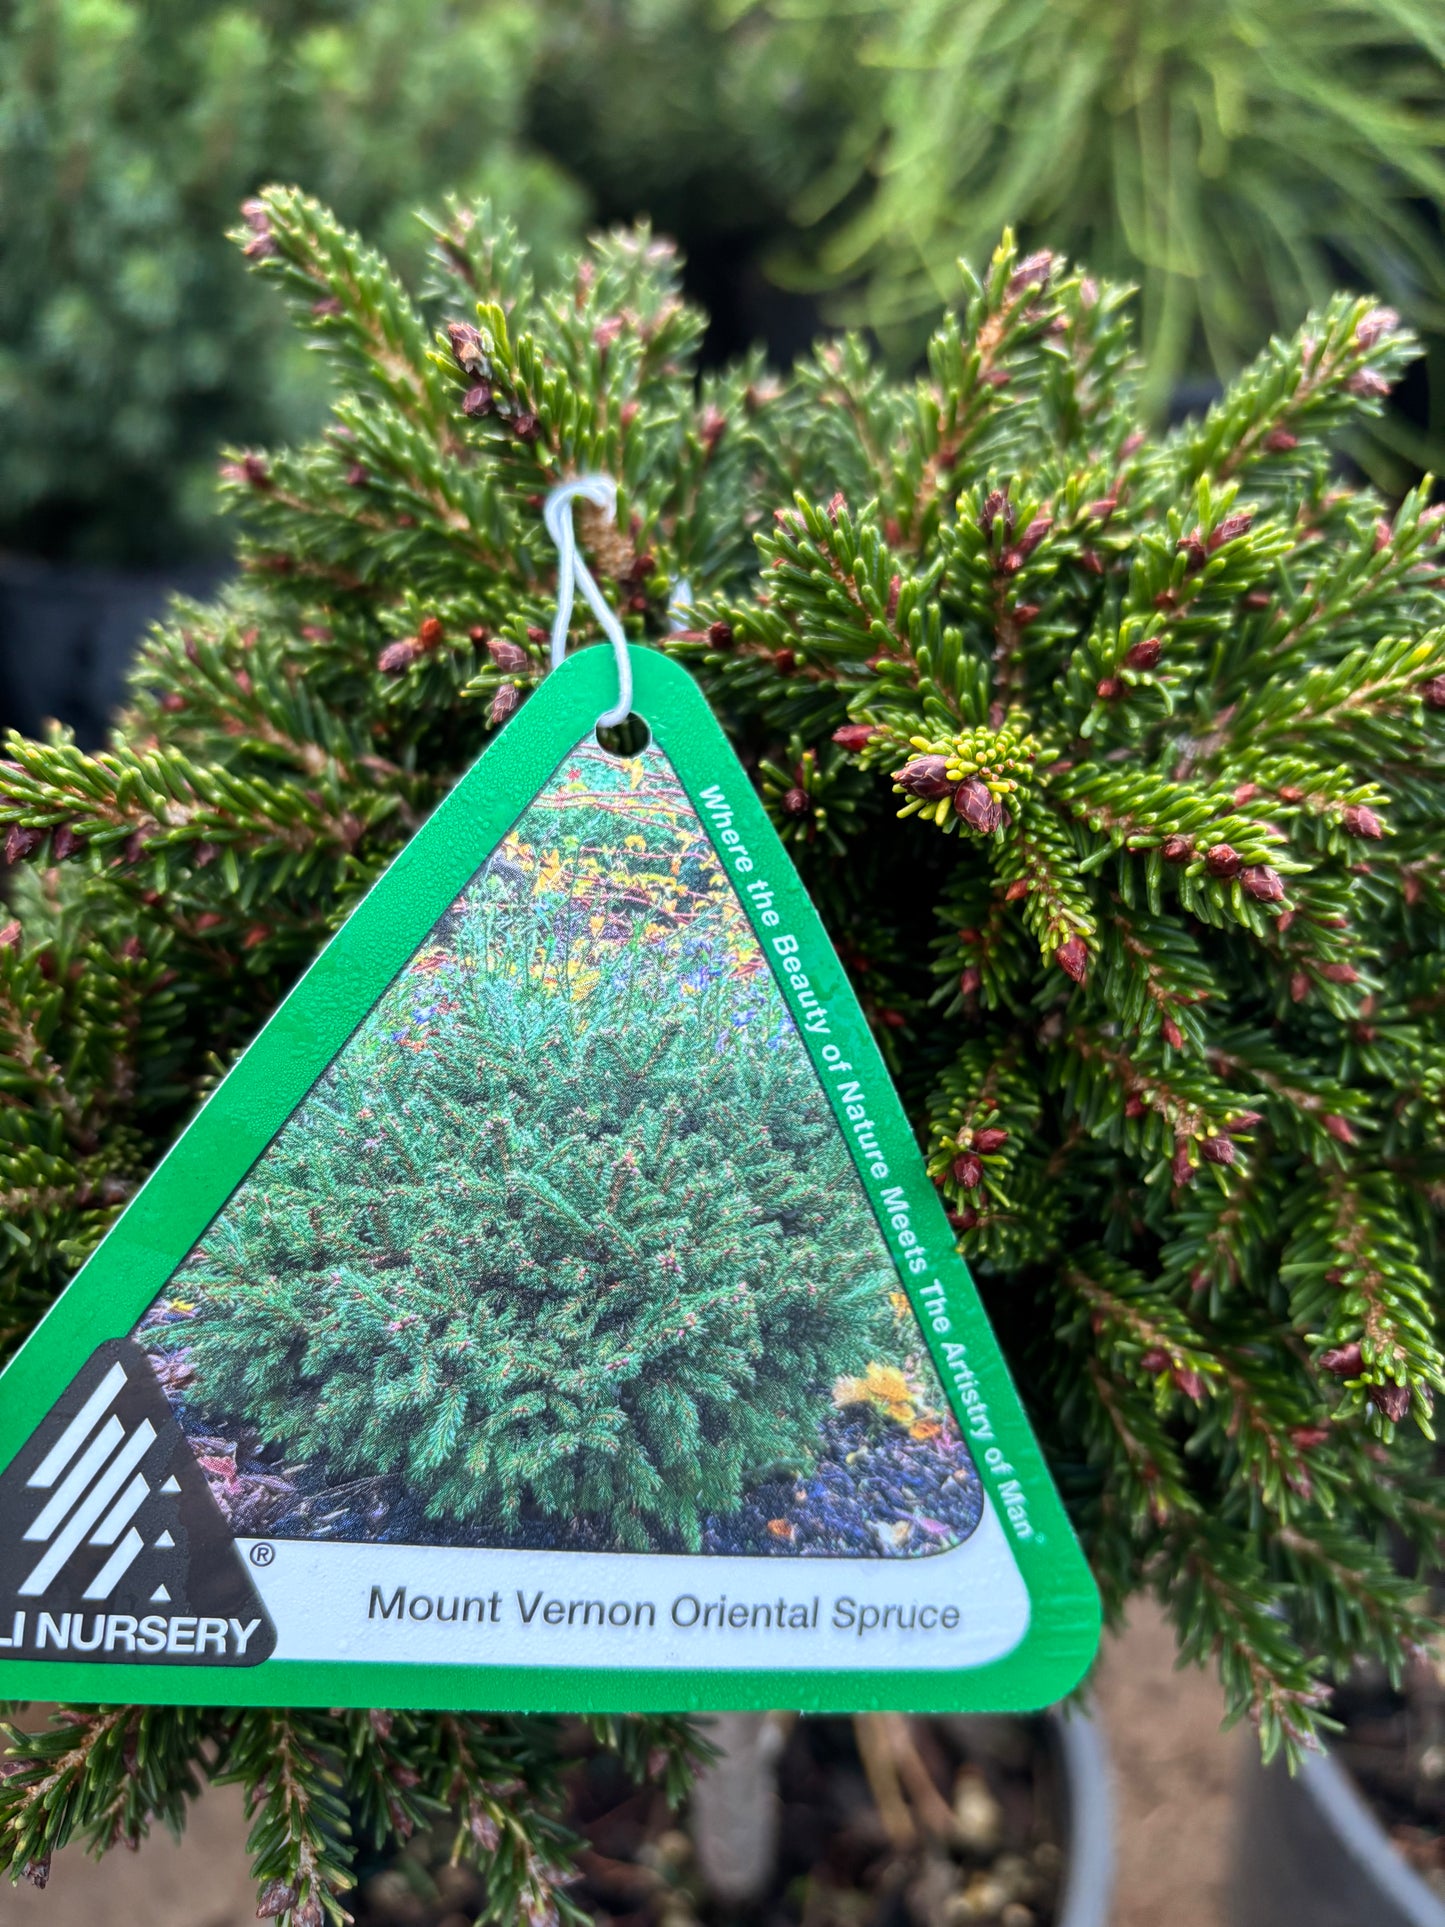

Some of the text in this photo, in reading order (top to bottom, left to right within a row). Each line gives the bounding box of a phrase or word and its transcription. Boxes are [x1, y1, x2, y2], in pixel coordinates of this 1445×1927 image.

[699, 784, 753, 873] Where
[746, 879, 780, 927] the
[771, 934, 831, 1034] Beauty
[821, 1044, 853, 1072] of
[837, 1081, 889, 1179] Nature
[879, 1186, 928, 1274] Meets
[919, 1278, 951, 1334] The
[940, 1341, 995, 1440] Artistry
[984, 1446, 1016, 1477] of
[35, 1611, 262, 1657] NURSERY
[367, 1584, 961, 1637] Mount Vernon Oriental Spruce
